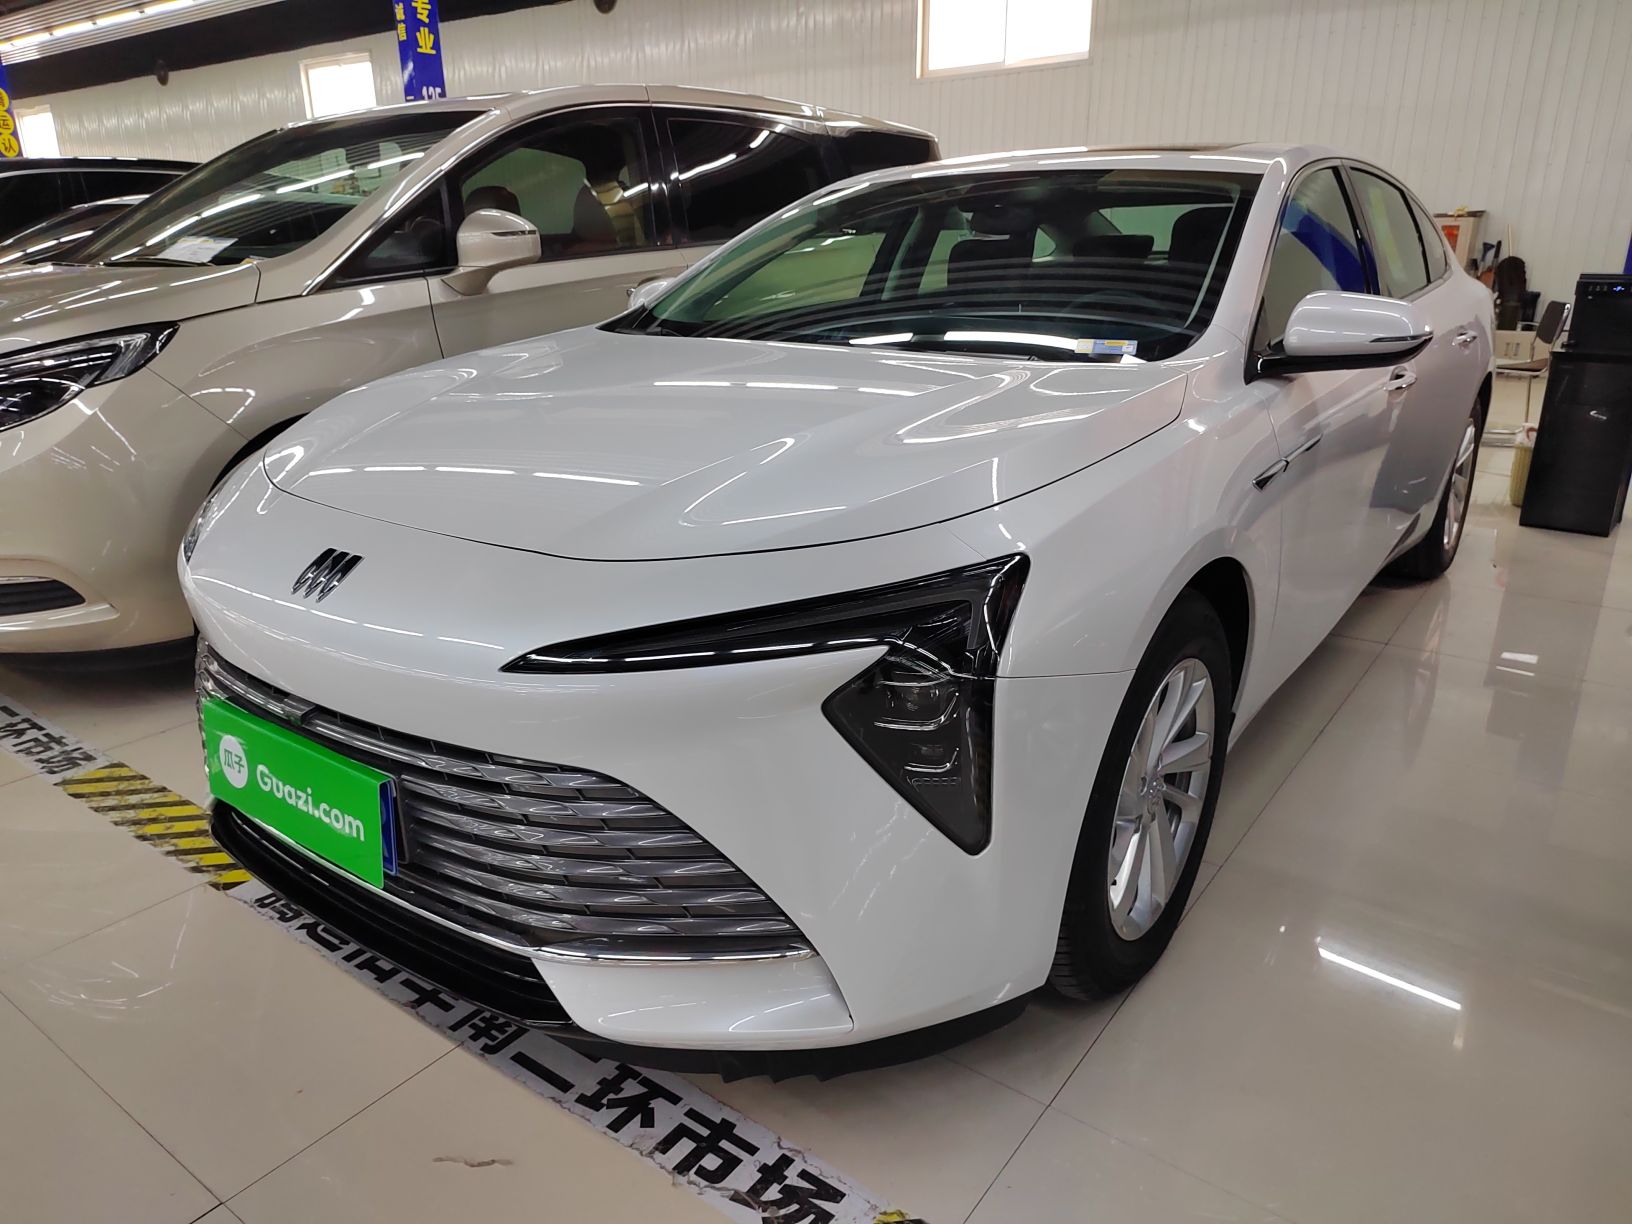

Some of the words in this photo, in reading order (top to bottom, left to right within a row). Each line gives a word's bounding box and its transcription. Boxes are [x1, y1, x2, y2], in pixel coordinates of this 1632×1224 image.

[411, 0, 437, 54] 专业
[223, 748, 245, 775] 瓜子
[256, 764, 366, 842] Guazi.com
